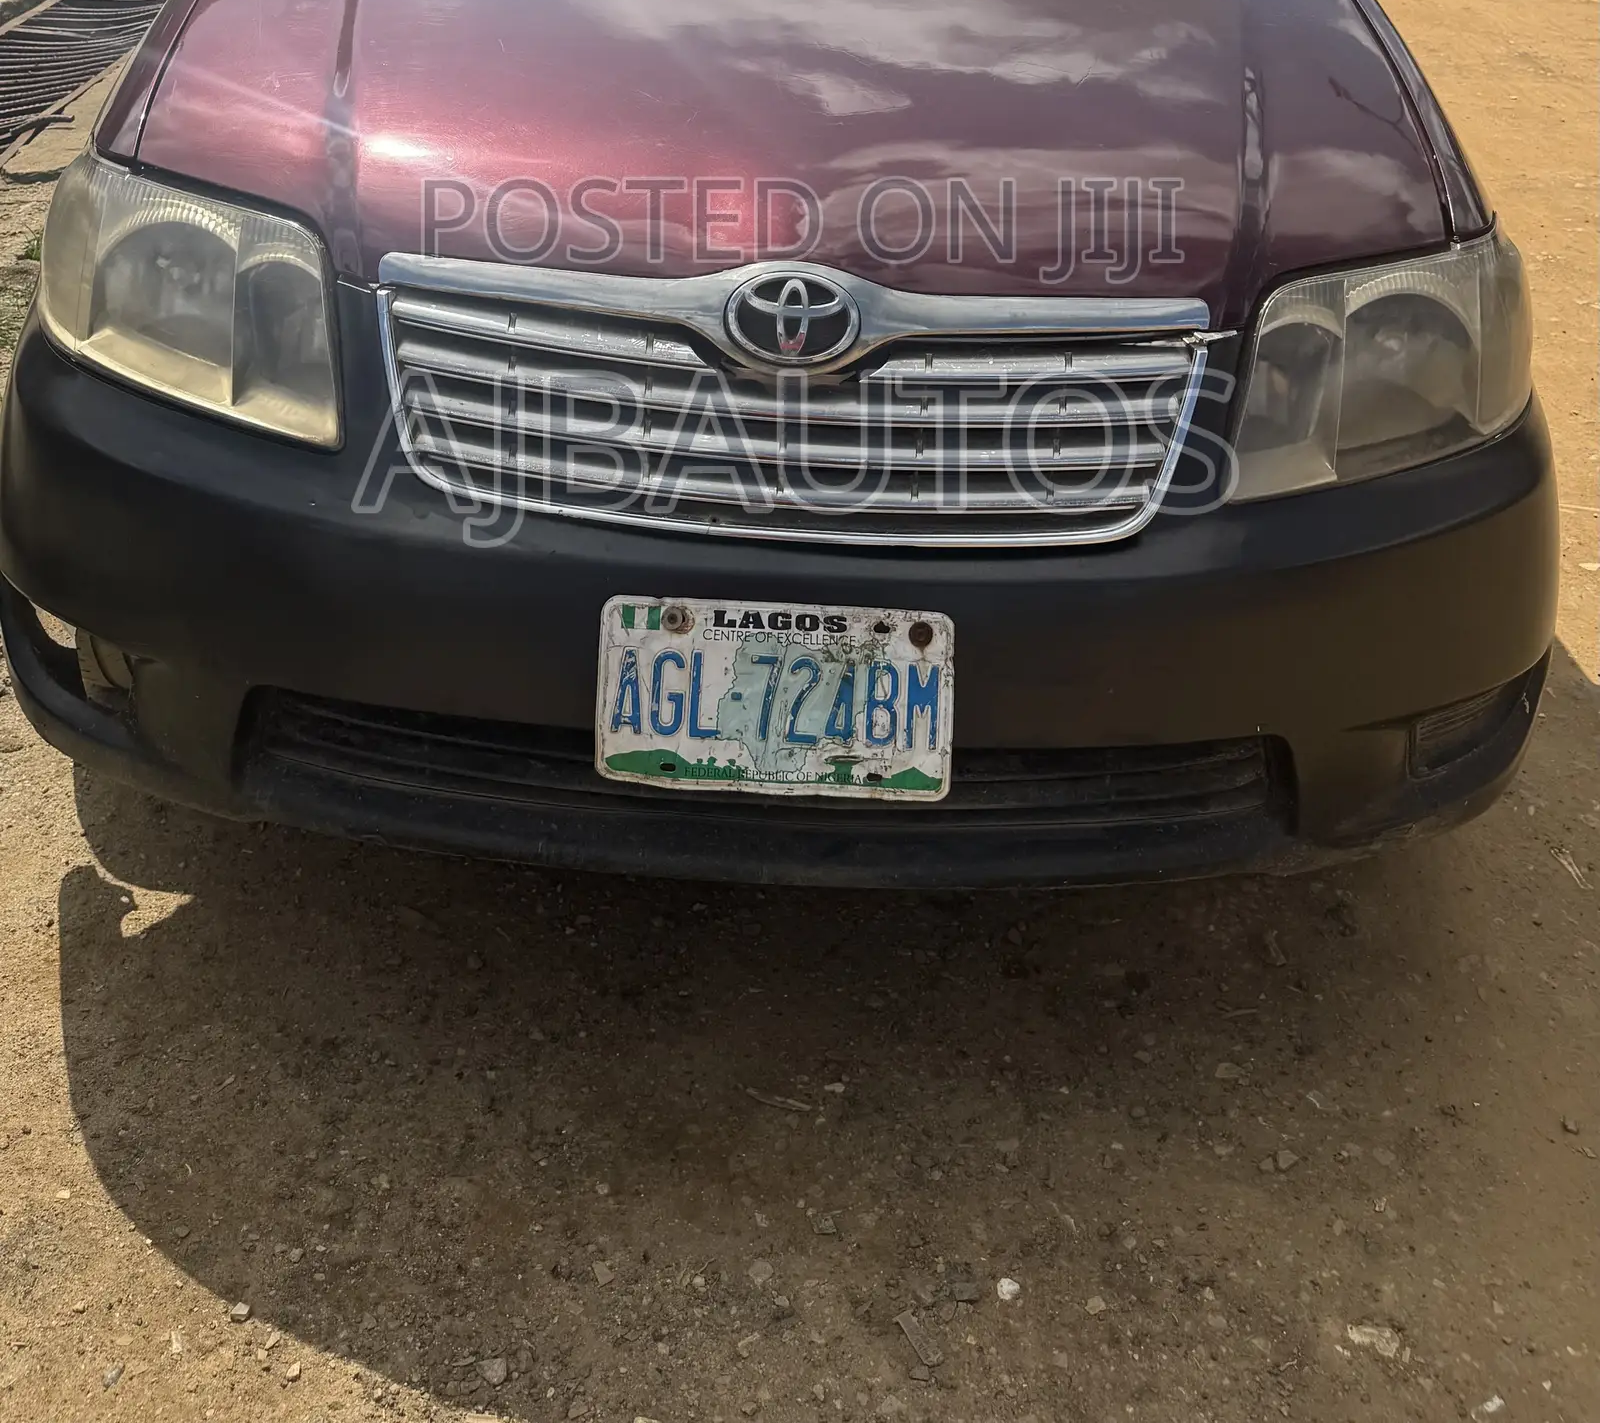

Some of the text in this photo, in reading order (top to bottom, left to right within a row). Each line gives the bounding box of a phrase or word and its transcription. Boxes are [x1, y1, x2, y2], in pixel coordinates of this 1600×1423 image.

[713, 609, 848, 633] LAGOS
[703, 628, 857, 647] CENTRE OF EXCELLENCE
[684, 766, 864, 784] FEDERAL REPUBLIC OF NIGERIA
